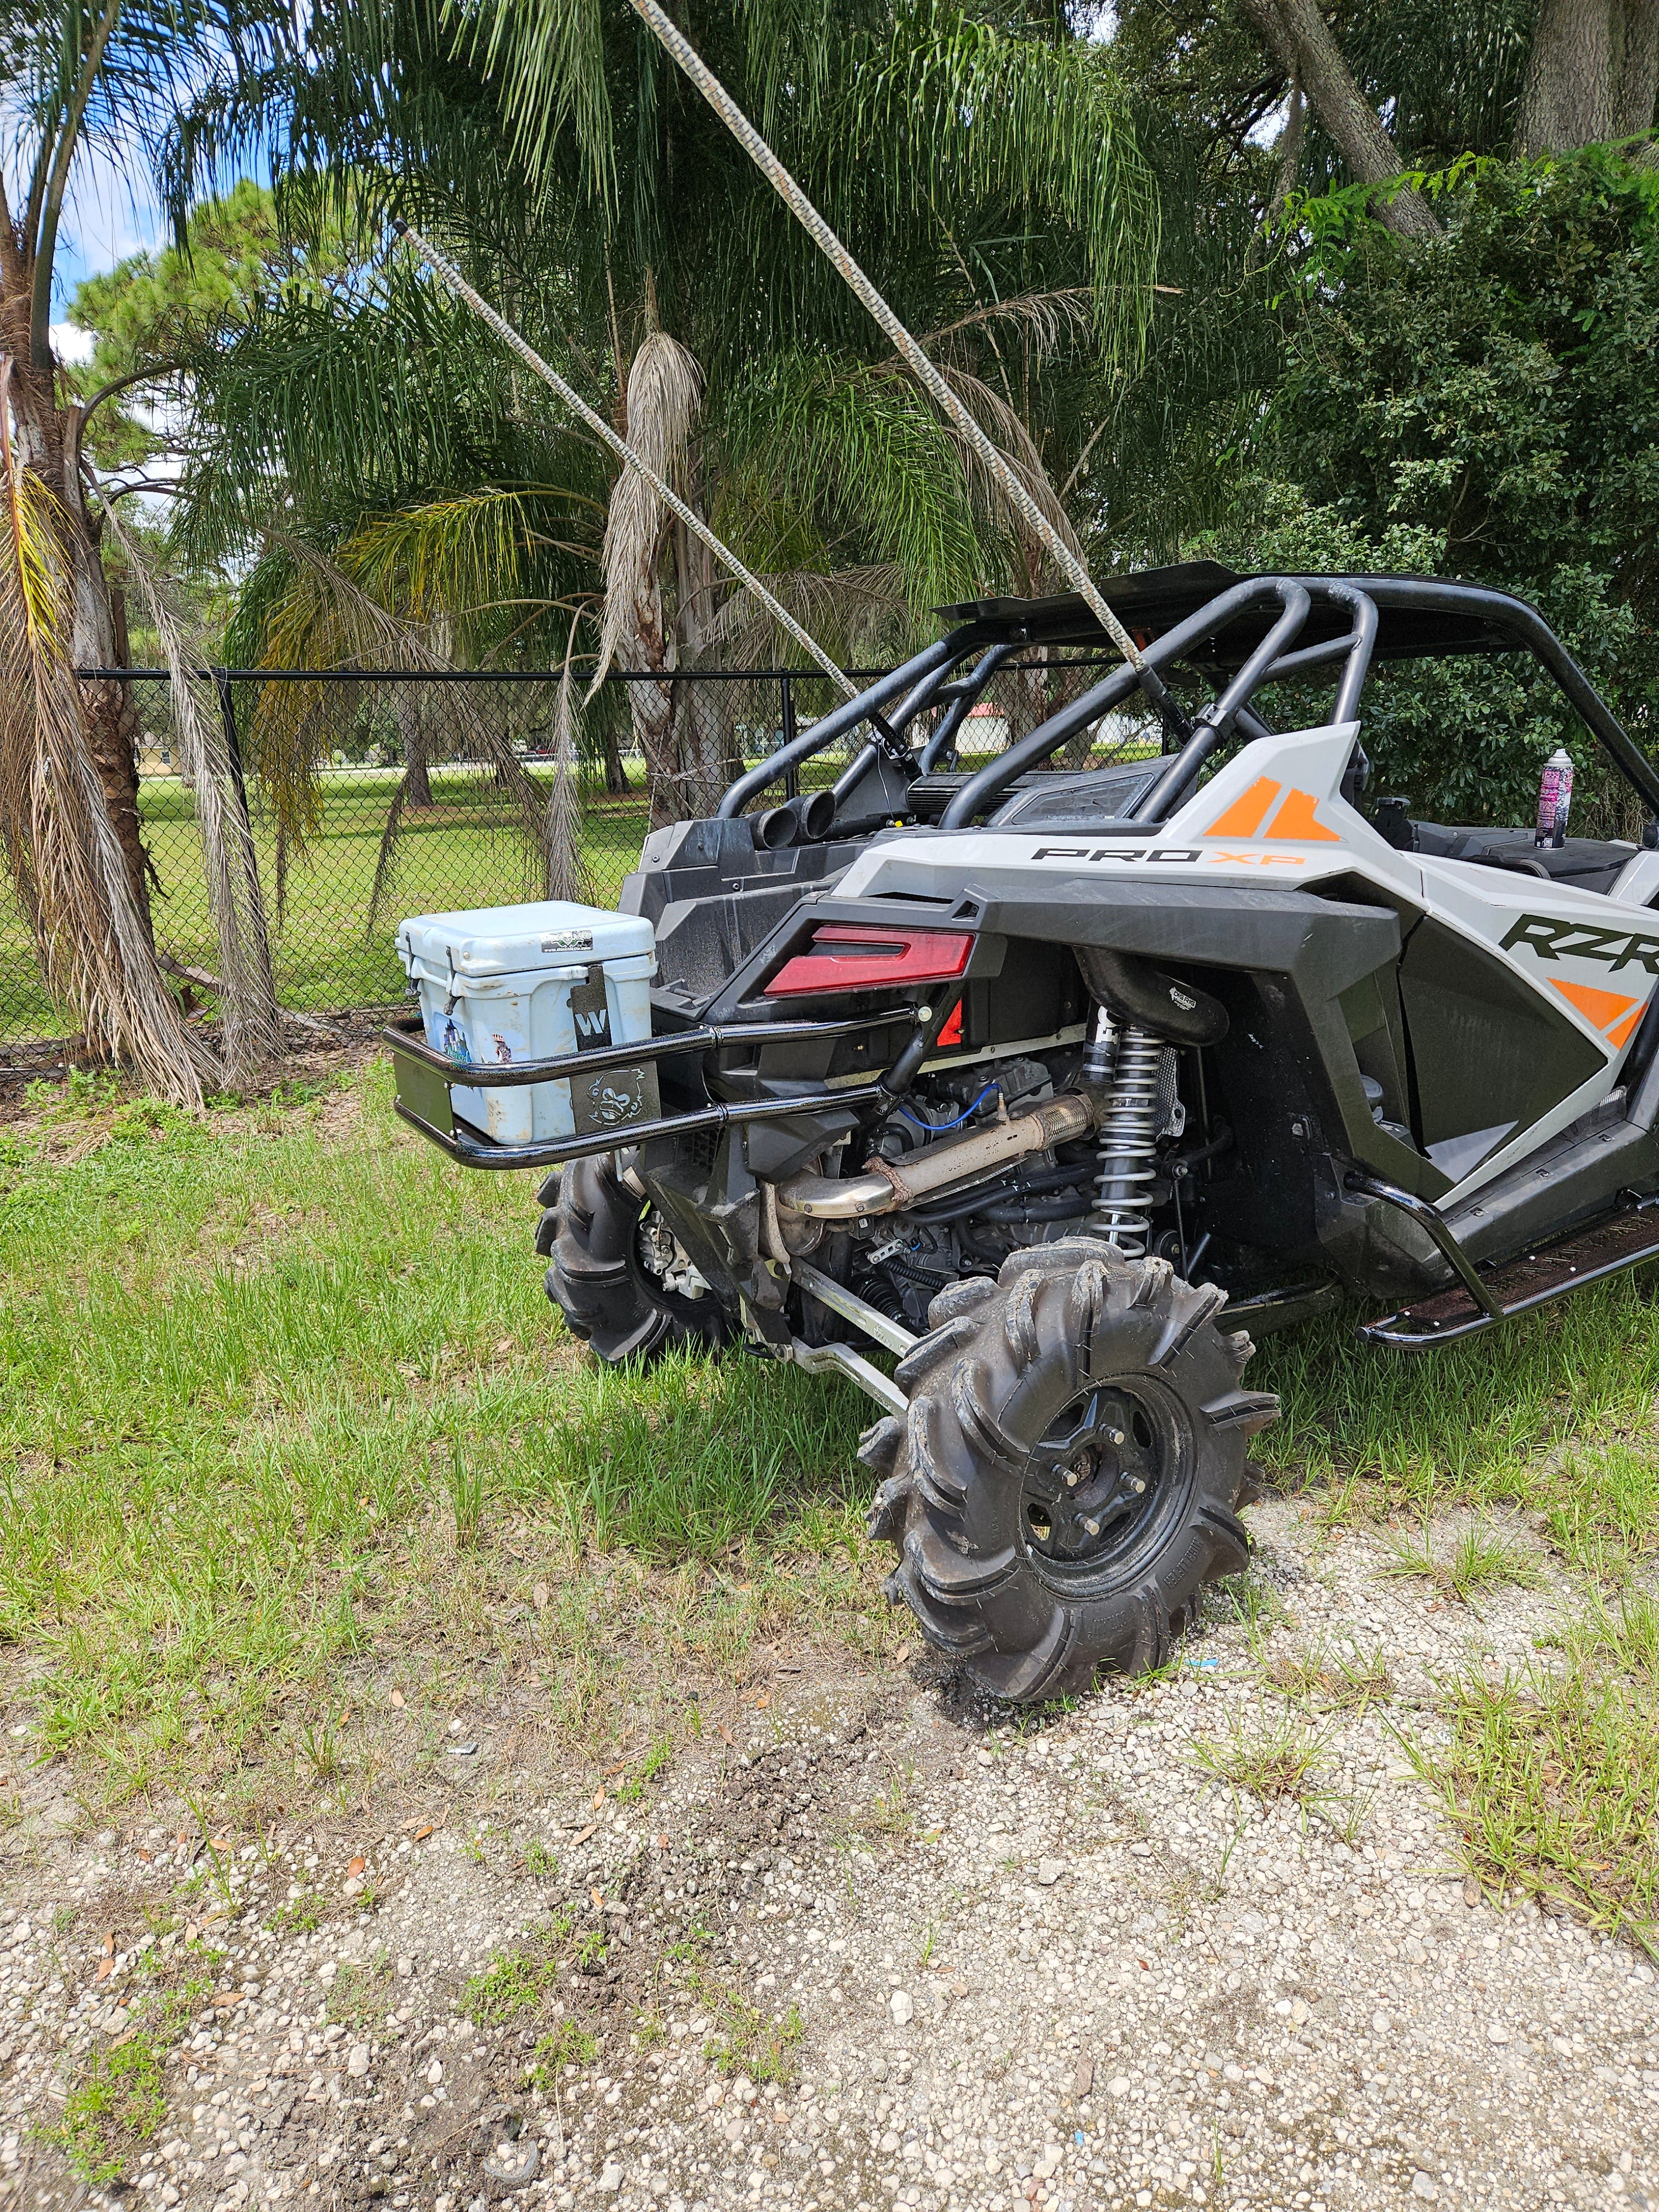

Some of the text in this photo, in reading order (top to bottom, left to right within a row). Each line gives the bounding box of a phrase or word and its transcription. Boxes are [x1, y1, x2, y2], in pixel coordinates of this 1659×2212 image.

[1030, 848, 1306, 865] PRO XP
[1498, 913, 1659, 975] RZR
